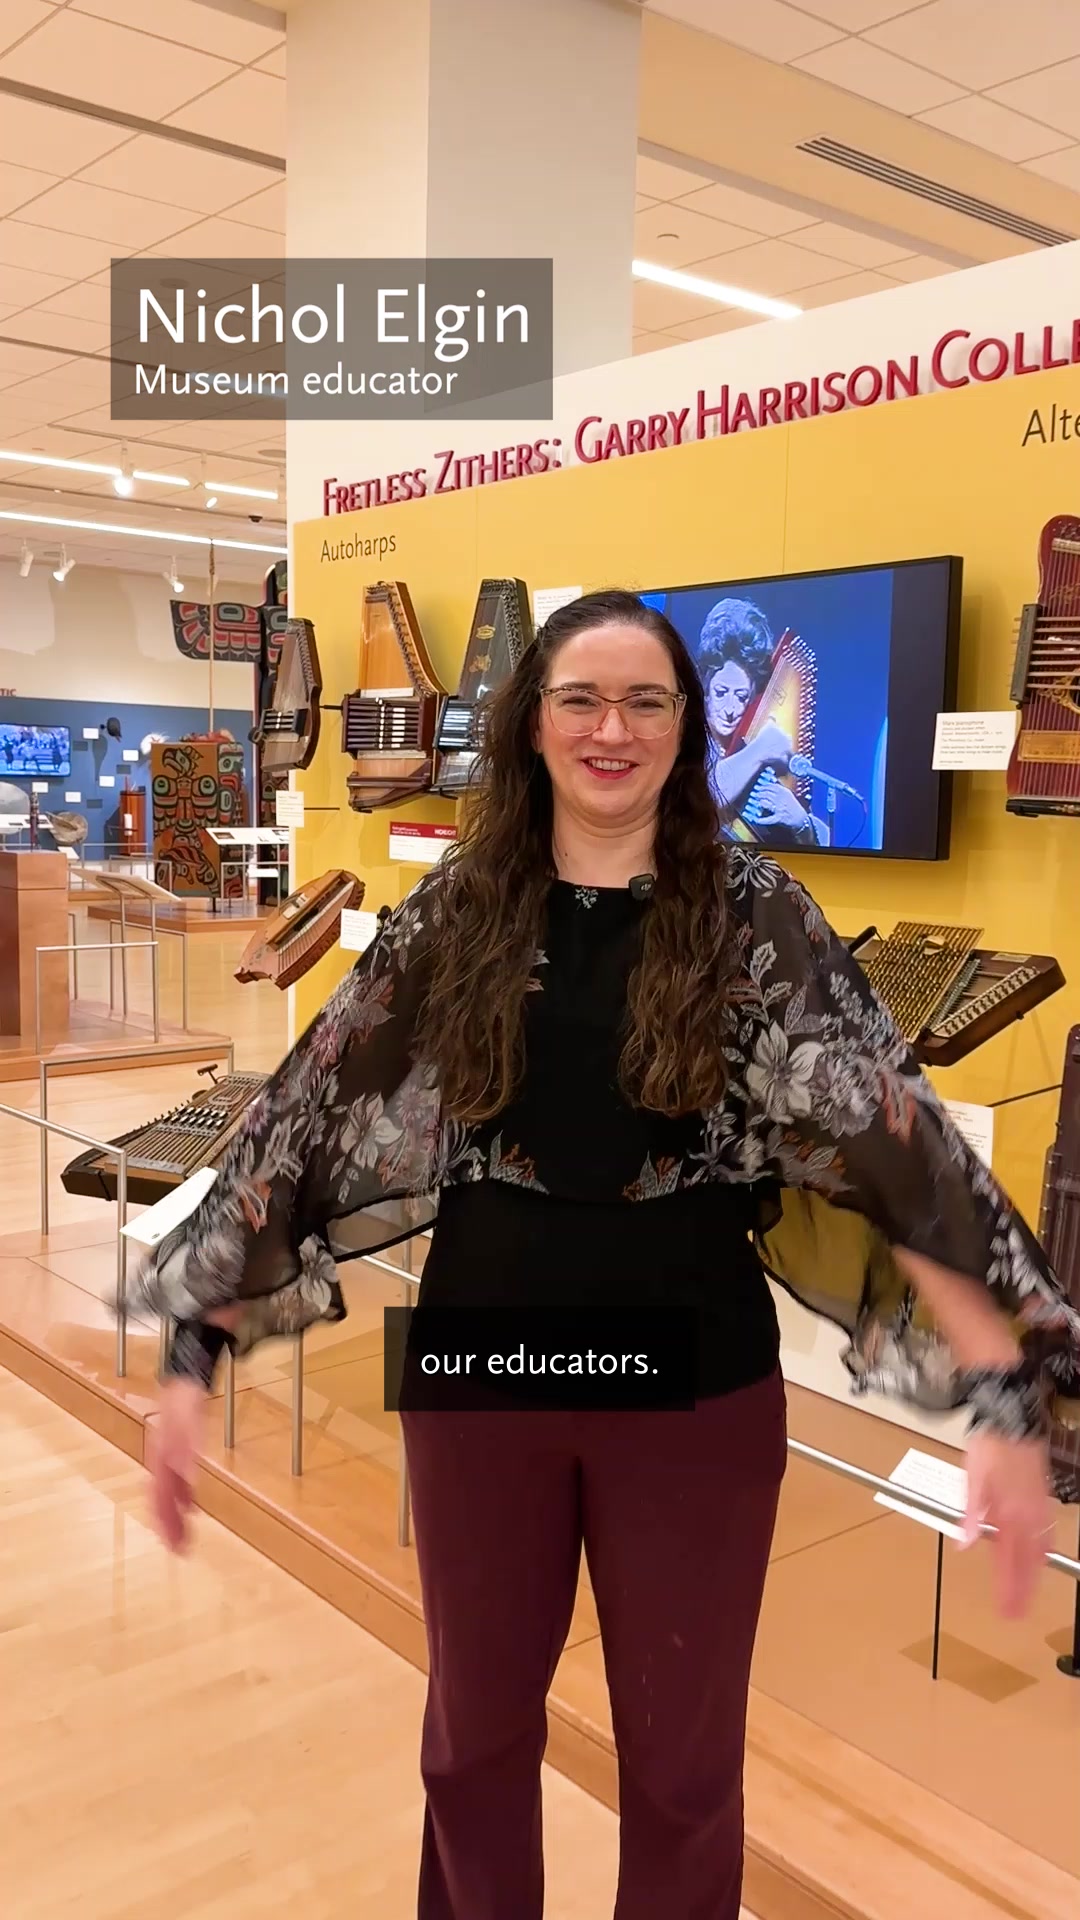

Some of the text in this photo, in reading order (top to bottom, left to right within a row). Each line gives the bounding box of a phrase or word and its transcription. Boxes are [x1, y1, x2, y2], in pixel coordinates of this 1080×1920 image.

[323, 477, 427, 516] FRETLESS
[575, 415, 690, 463] GARRY
[696, 355, 919, 440] HARRISON
[320, 532, 397, 563] Autoharps
